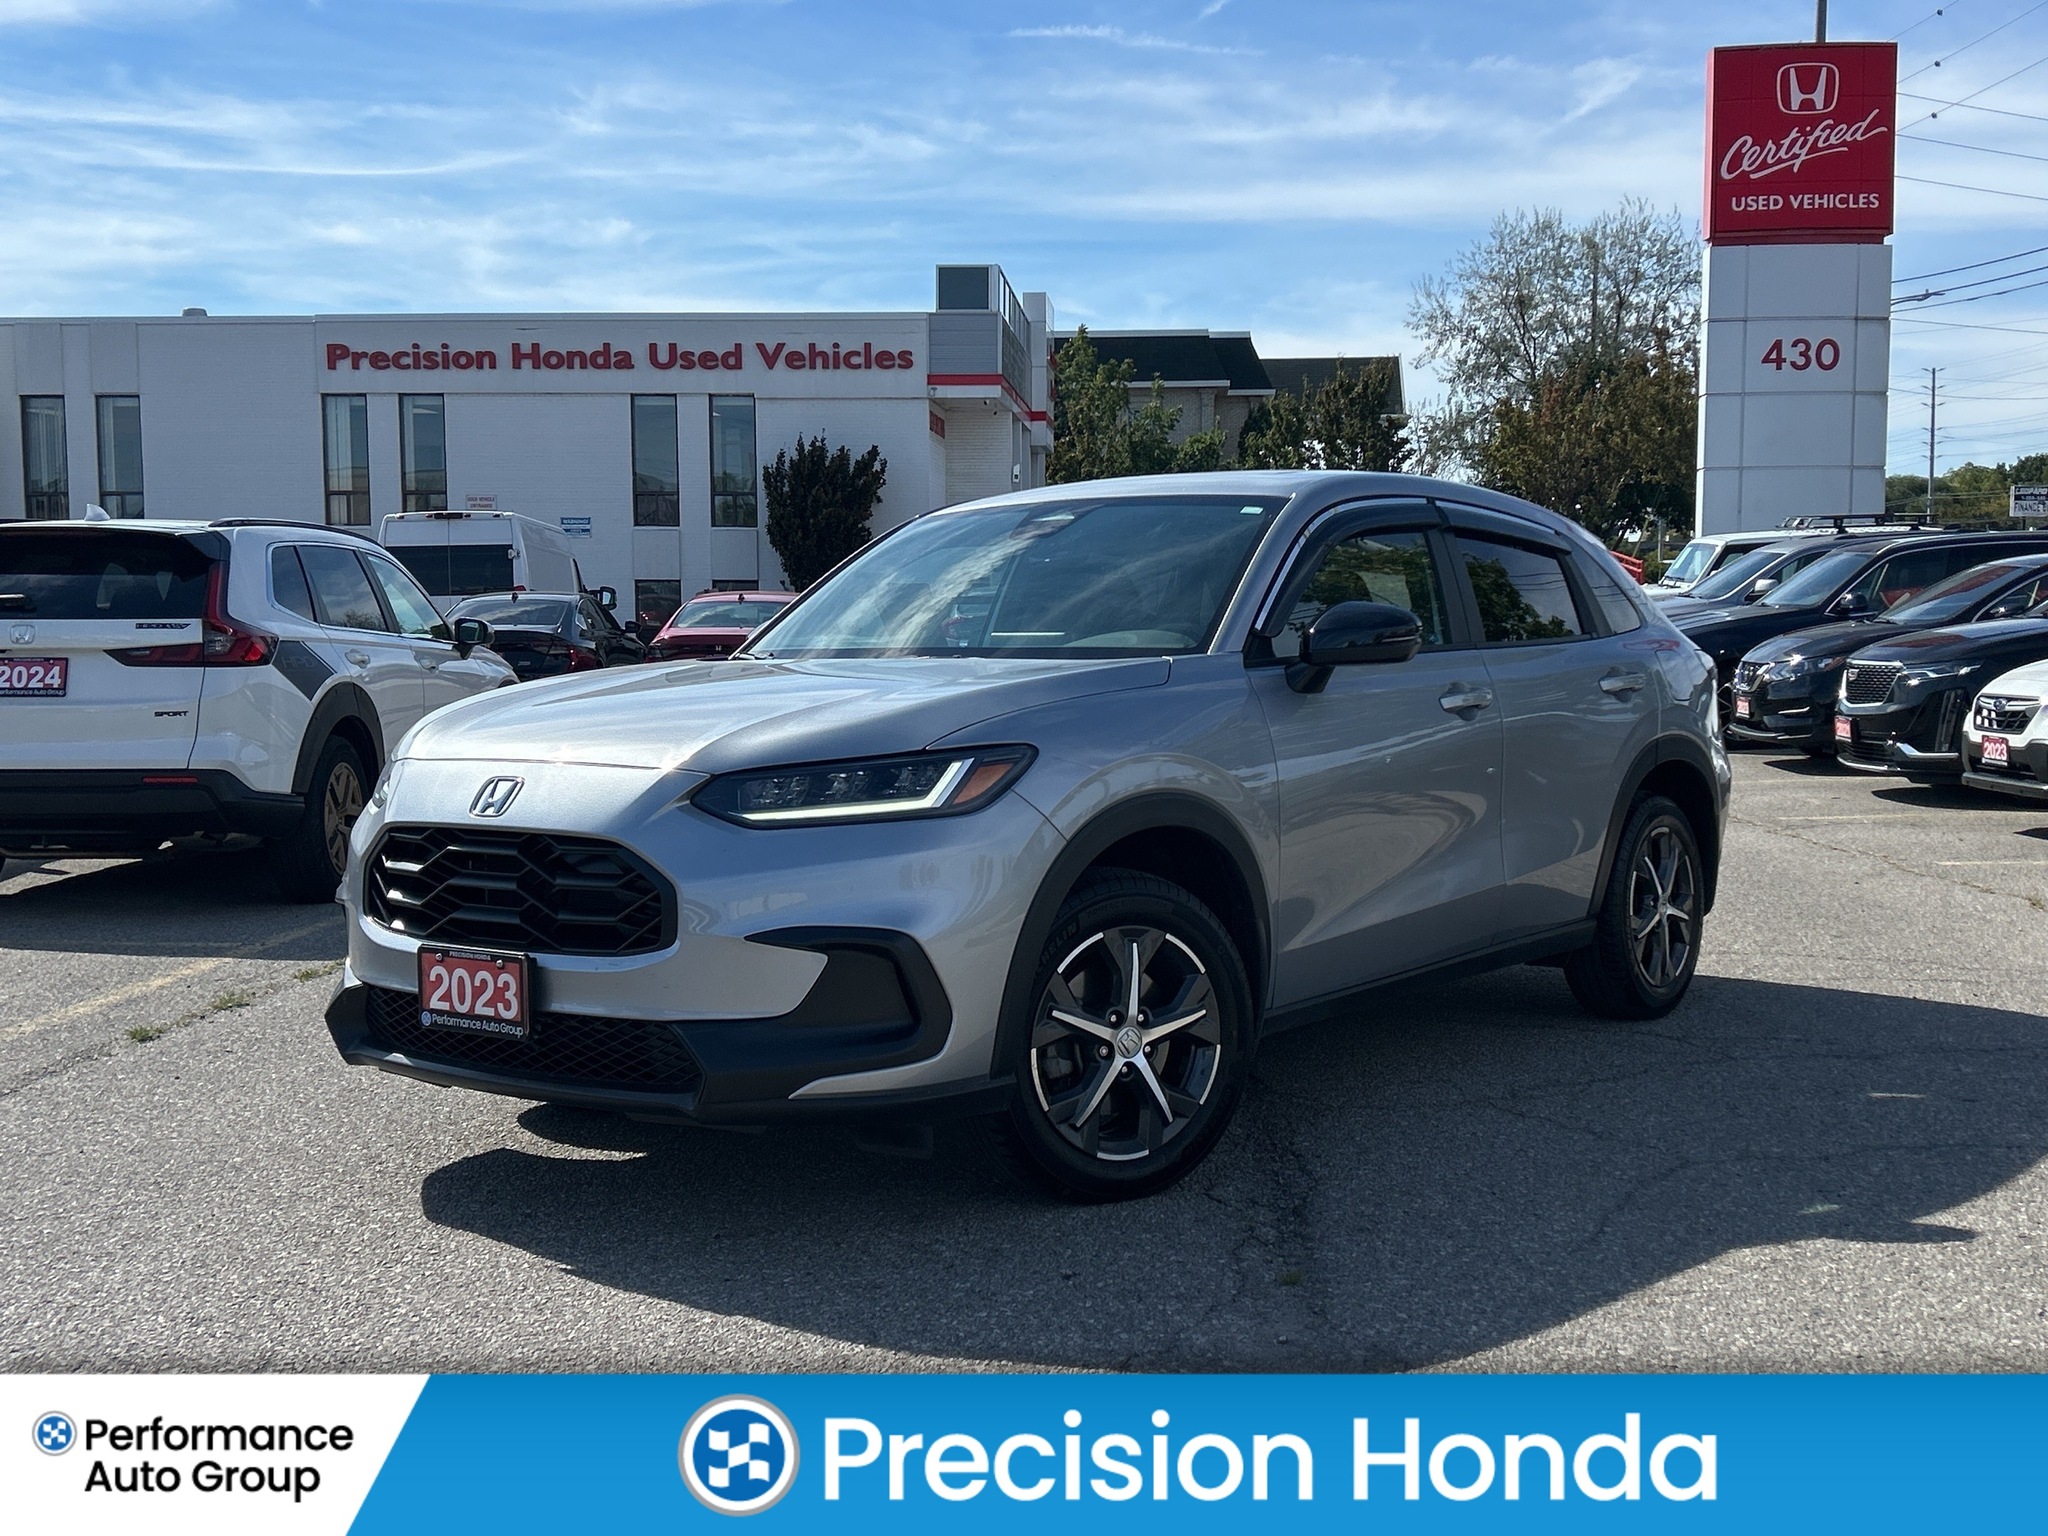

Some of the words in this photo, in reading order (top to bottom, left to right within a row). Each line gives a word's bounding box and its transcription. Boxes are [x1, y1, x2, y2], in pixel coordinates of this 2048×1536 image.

[1720, 109, 1888, 180] Certified
[1731, 195, 1784, 212] USED
[1789, 193, 1880, 210] VEHICLES
[326, 343, 496, 370] Precision
[511, 343, 634, 370] Honda
[649, 343, 742, 370] Used
[756, 343, 914, 370] Vehicles
[1761, 337, 1840, 371] 430
[0, 665, 61, 688] 2024
[154, 710, 189, 718] SPORT
[1984, 741, 2008, 761] 2023
[429, 965, 519, 1020] 2023
[432, 1013, 481, 1030] Performance
[481, 1020, 500, 1033] Auto
[500, 1022, 524, 1039] Group
